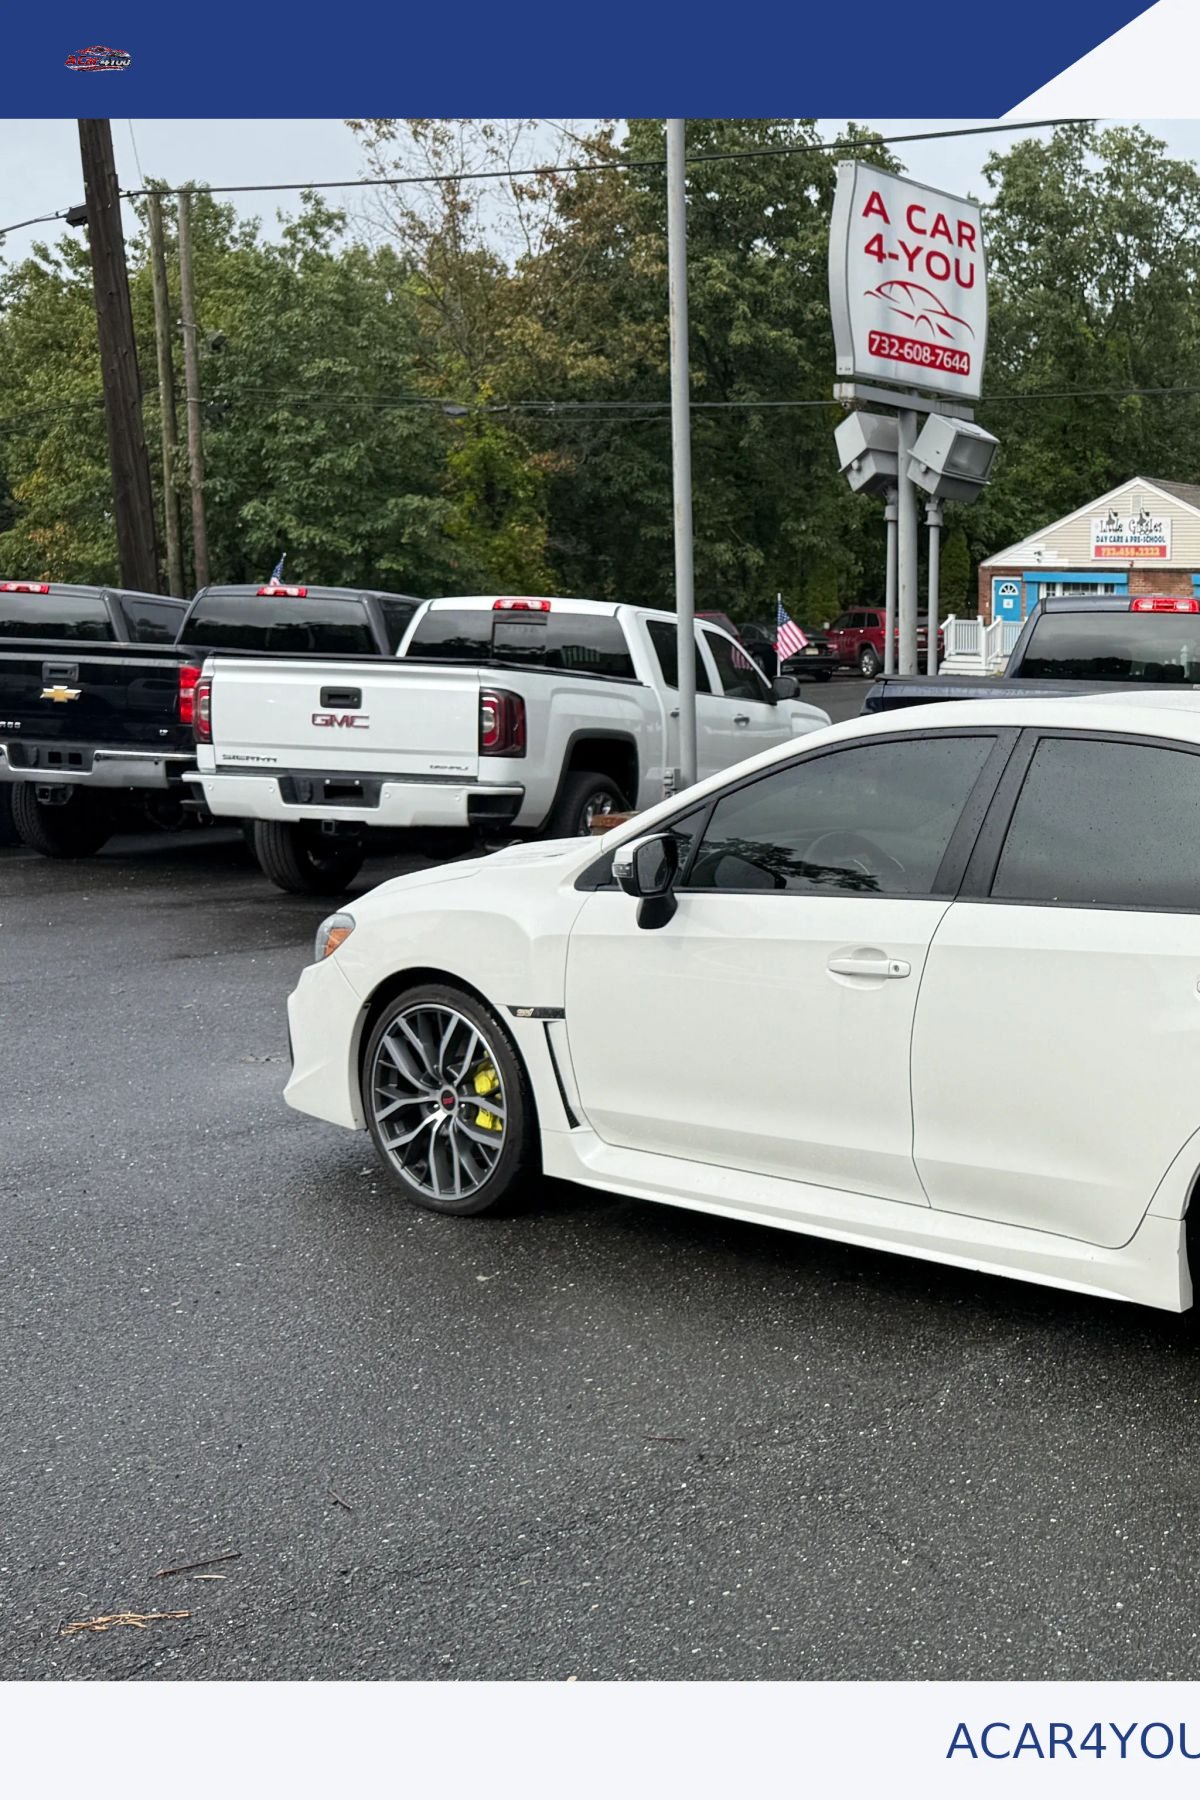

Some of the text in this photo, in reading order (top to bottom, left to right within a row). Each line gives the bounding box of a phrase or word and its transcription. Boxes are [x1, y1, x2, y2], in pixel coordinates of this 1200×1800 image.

[862, 190, 977, 252] A CAR
[863, 232, 975, 290] 4-YOU
[869, 332, 970, 374] 732-608-7644
[1096, 535, 1108, 543] DAY
[1109, 535, 1124, 543] CARE
[1130, 535, 1166, 543] PRE-SCHOOL
[312, 713, 370, 729] GMC
